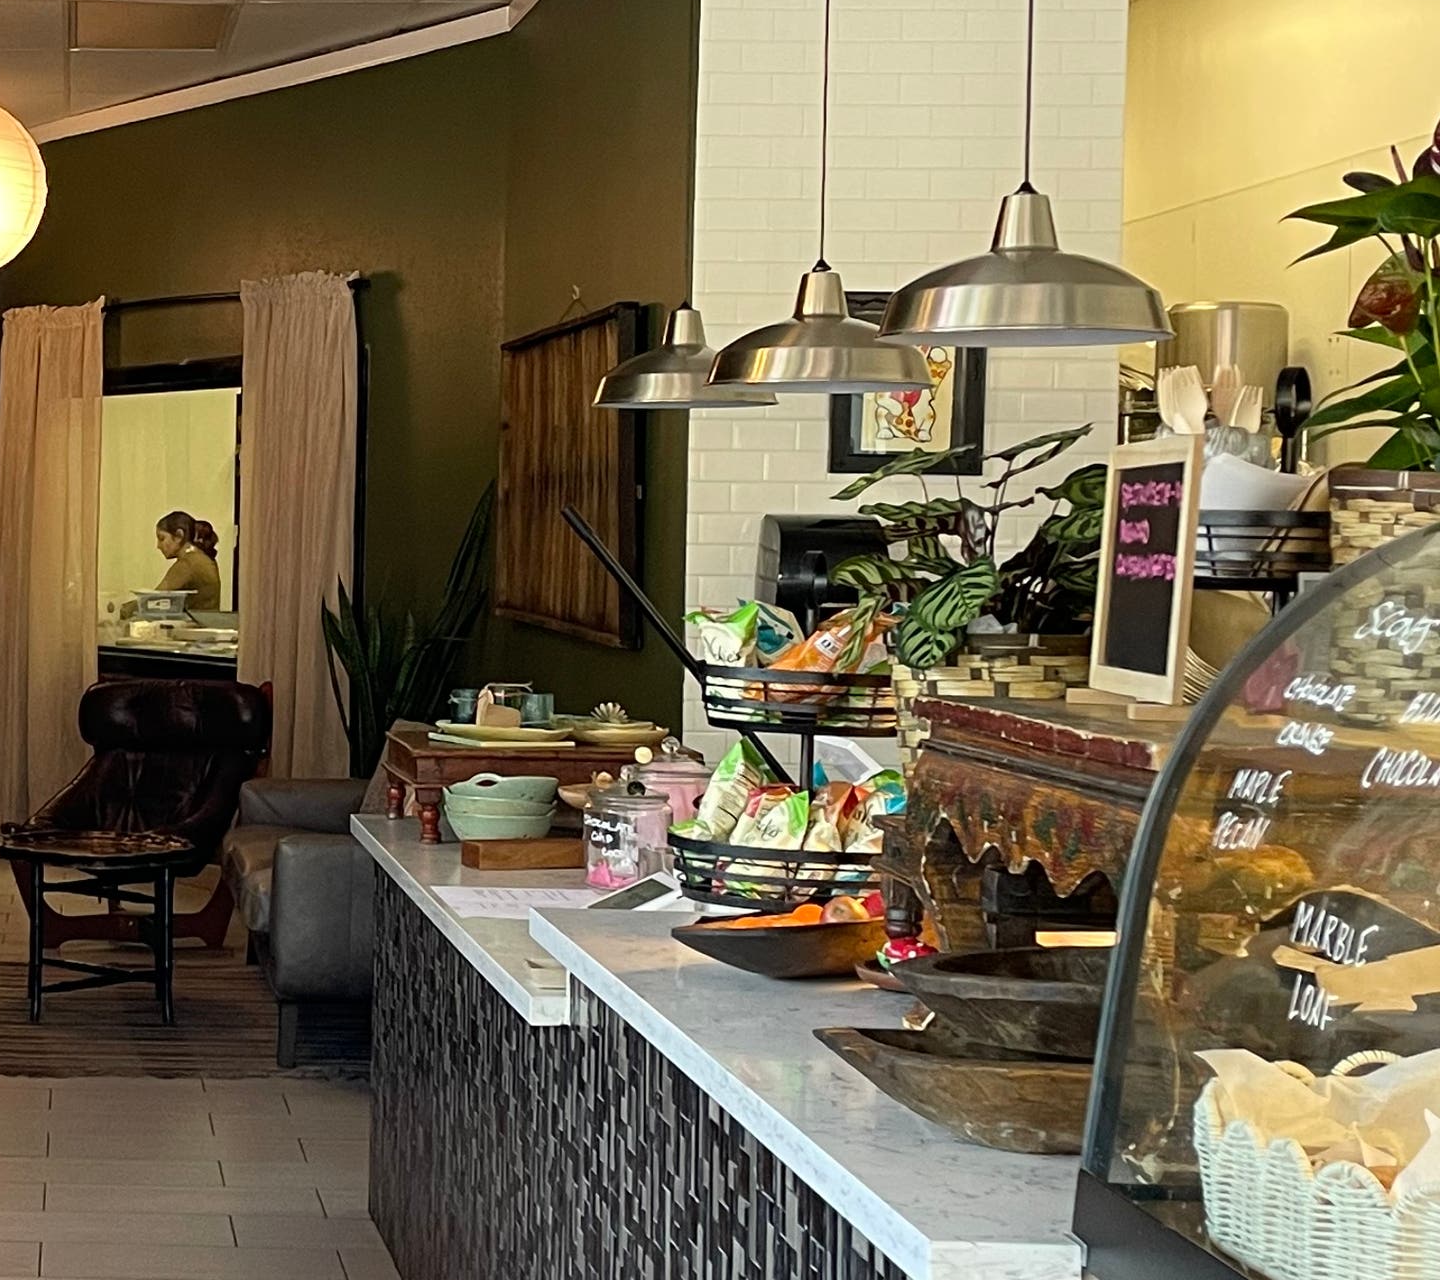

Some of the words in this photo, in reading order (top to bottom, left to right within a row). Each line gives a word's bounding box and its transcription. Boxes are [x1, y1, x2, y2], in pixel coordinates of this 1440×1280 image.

[1227, 769, 1293, 804] MAPLE
[1212, 810, 1271, 851] PECAN
[1289, 900, 1380, 968] MARBLE
[1287, 973, 1339, 1031] LOAF
